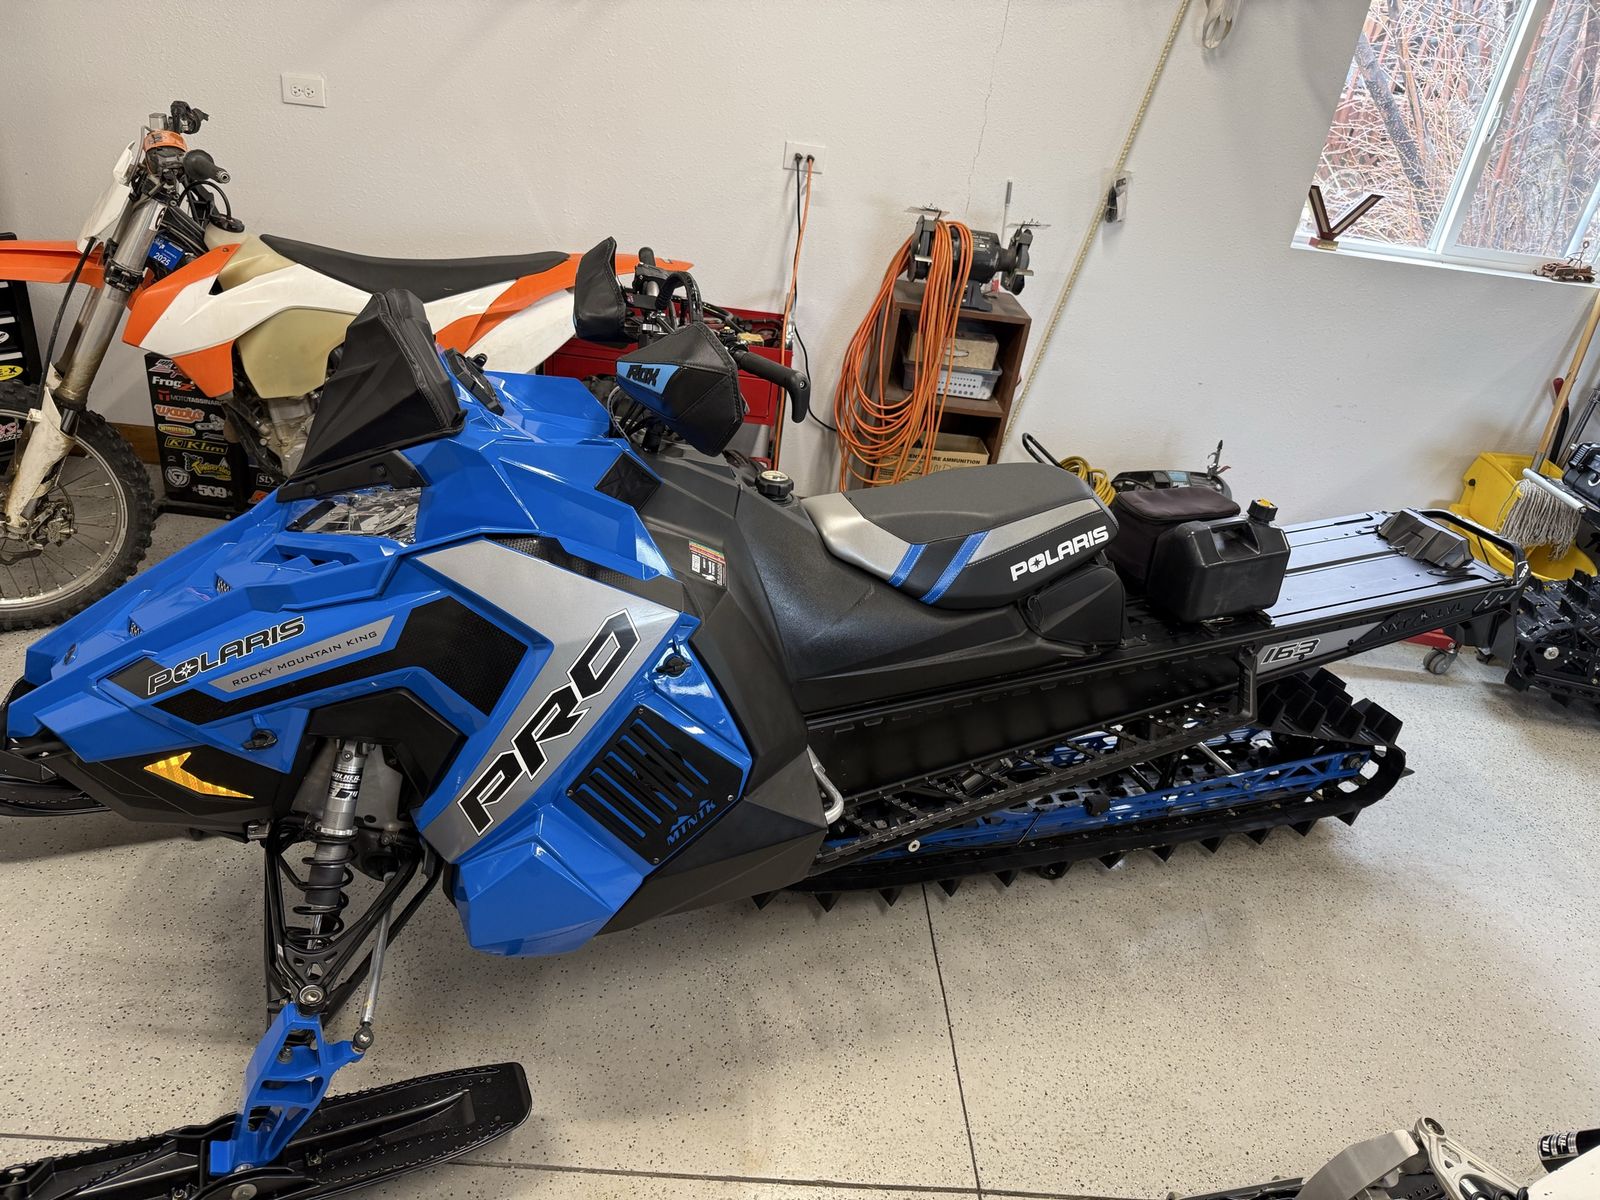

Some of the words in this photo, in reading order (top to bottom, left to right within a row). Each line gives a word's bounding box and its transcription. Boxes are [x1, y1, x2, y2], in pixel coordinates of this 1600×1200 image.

[153, 252, 171, 266] 2025
[942, 457, 981, 465] AMMUNITION
[197, 484, 228, 499] 509
[1009, 526, 1109, 582] POLARIS
[147, 616, 305, 695] POLARIS
[232, 667, 273, 687] ROCKY
[277, 643, 342, 671] MOUNTAIN
[345, 629, 378, 650] KING
[1260, 638, 1322, 666] 163
[457, 608, 641, 837] PRO
[666, 800, 717, 847] MTNTK
